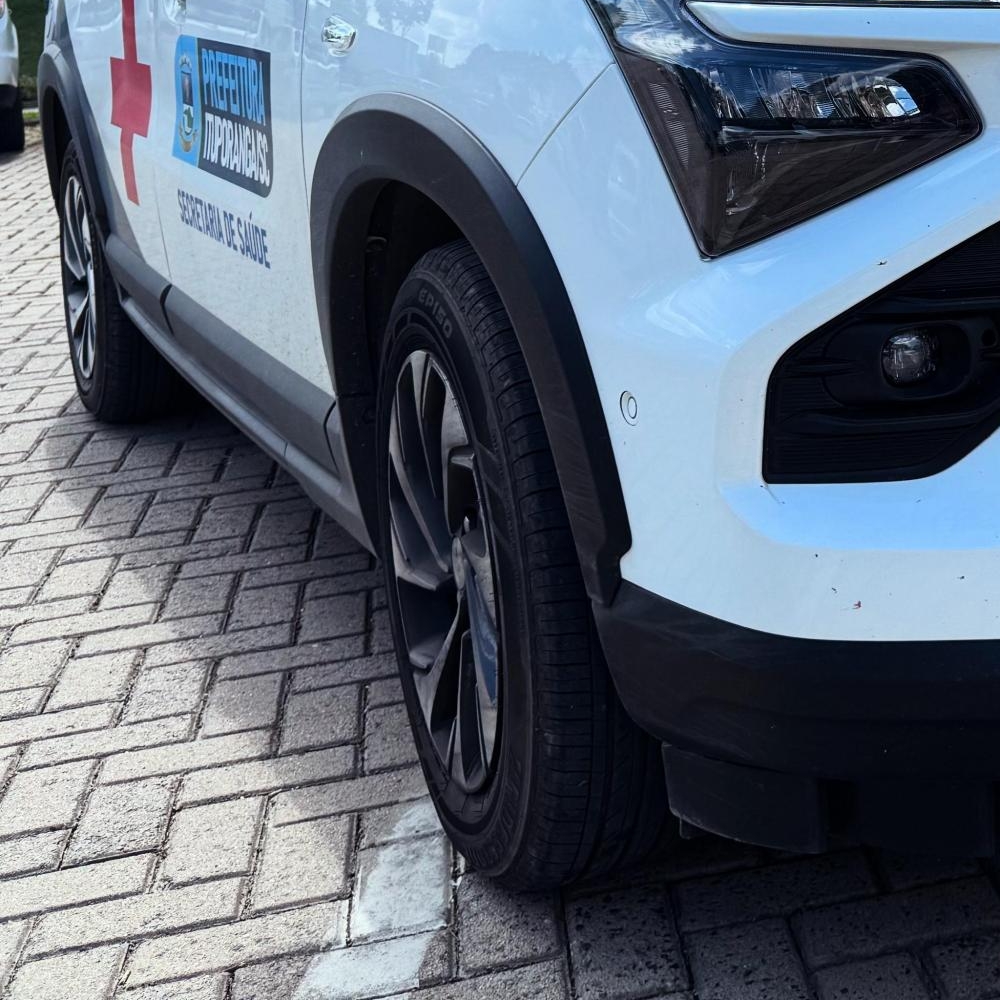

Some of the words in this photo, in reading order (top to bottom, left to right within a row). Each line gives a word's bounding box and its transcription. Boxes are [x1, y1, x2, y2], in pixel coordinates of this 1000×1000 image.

[201, 48, 266, 126] PREFEITURA
[203, 111, 270, 187] ITUPORANGA/SC
[177, 188, 224, 244] SECRETARIA
[223, 213, 238, 251] DE
[237, 211, 271, 269] SAÚDE
[418, 287, 453, 339] EP150
